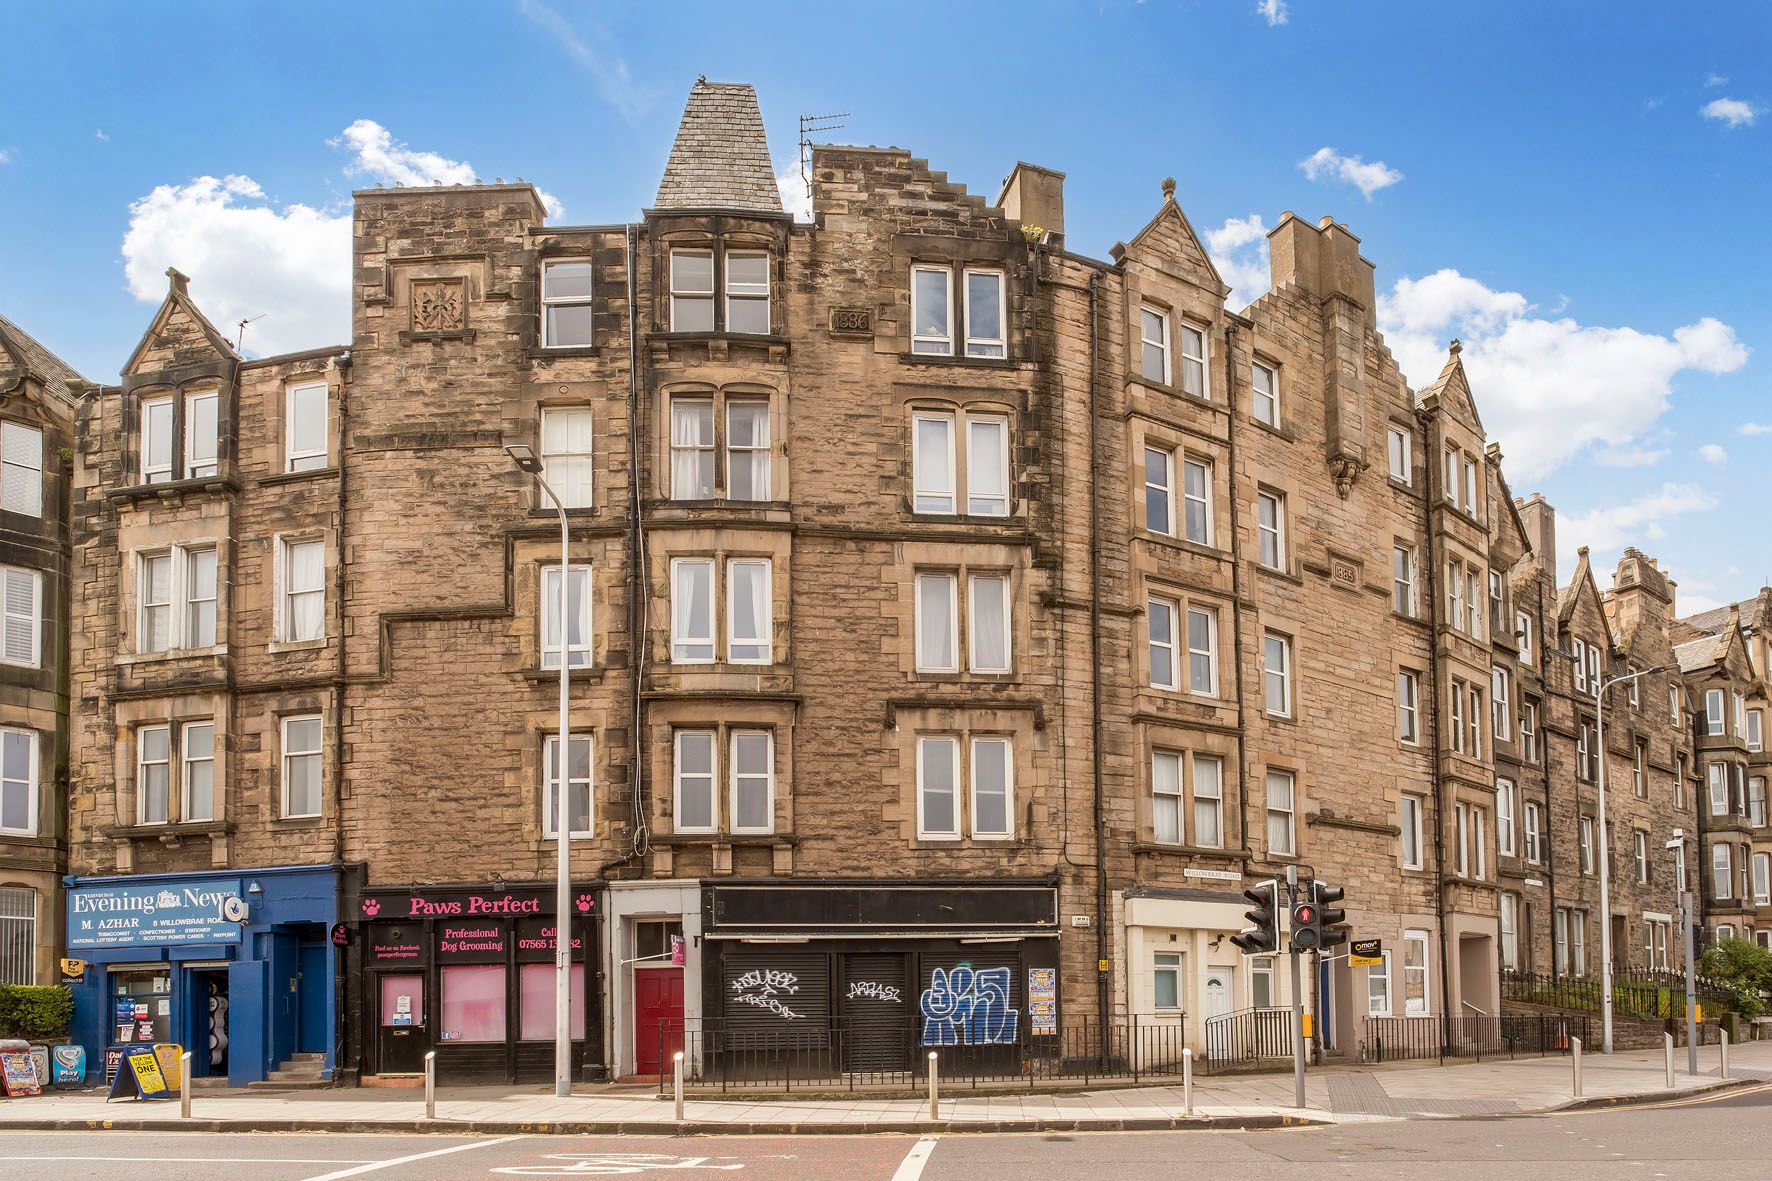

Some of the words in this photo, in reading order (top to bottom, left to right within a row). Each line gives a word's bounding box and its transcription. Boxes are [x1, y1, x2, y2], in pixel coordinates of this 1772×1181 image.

[834, 311, 867, 329] 1886
[1223, 872, 1240, 880] ROAD
[73, 891, 155, 915] Evening
[409, 897, 462, 915] Paws
[467, 895, 540, 914] Perfect
[81, 920, 94, 930] M.
[98, 917, 140, 930] AZHAR
[153, 919, 158, 927] 8
[160, 917, 205, 927] WILLOWBRAE
[206, 917, 225, 925] ROA
[138, 928, 176, 936] CONFECTIONER
[334, 931, 346, 939] Paws
[444, 927, 499, 939] Professional
[541, 927, 557, 938] Call
[332, 937, 348, 945] Perfect
[519, 939, 546, 949] 07565
[549, 939, 581, 949] 1382
[440, 941, 457, 953] Dog
[459, 940, 503, 951] Grooming
[60, 1069, 79, 1077] Play
[136, 1064, 156, 1074] ONE
